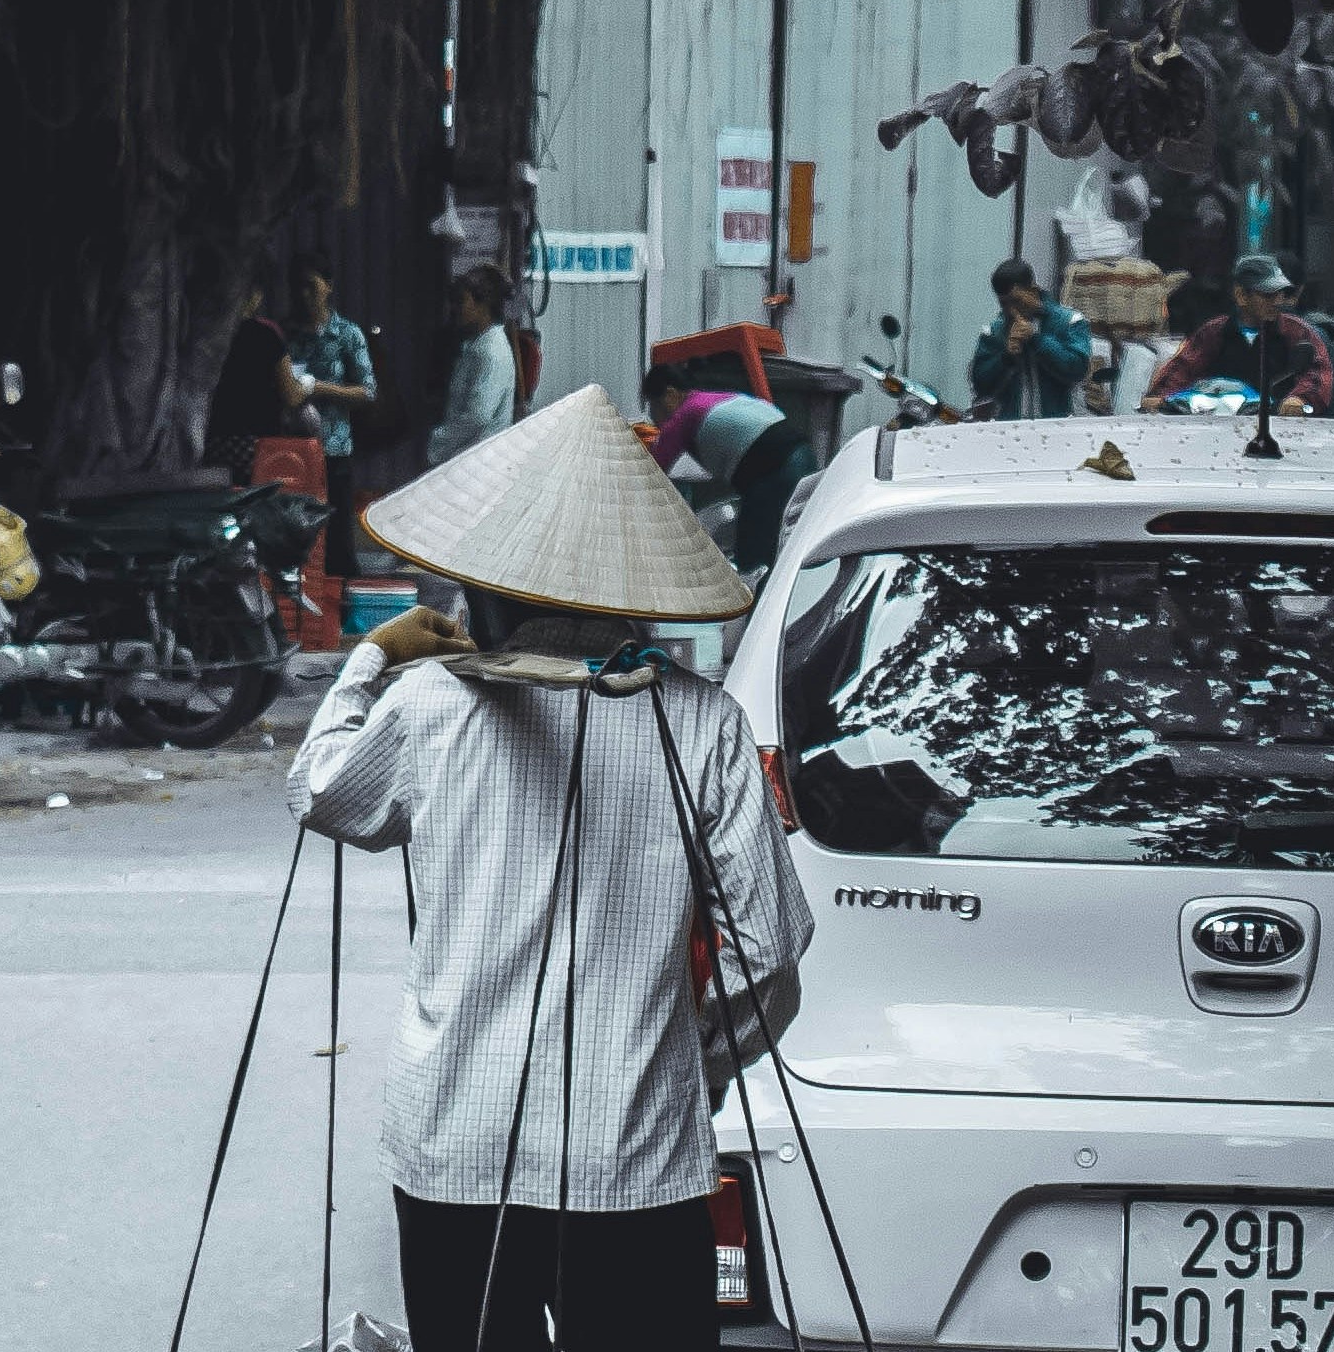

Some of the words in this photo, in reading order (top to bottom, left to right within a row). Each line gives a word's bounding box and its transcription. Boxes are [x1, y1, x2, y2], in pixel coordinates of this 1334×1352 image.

[835, 883, 981, 921] morning
[1212, 921, 1285, 953] KIA
[1182, 1209, 1305, 1279] 29D
